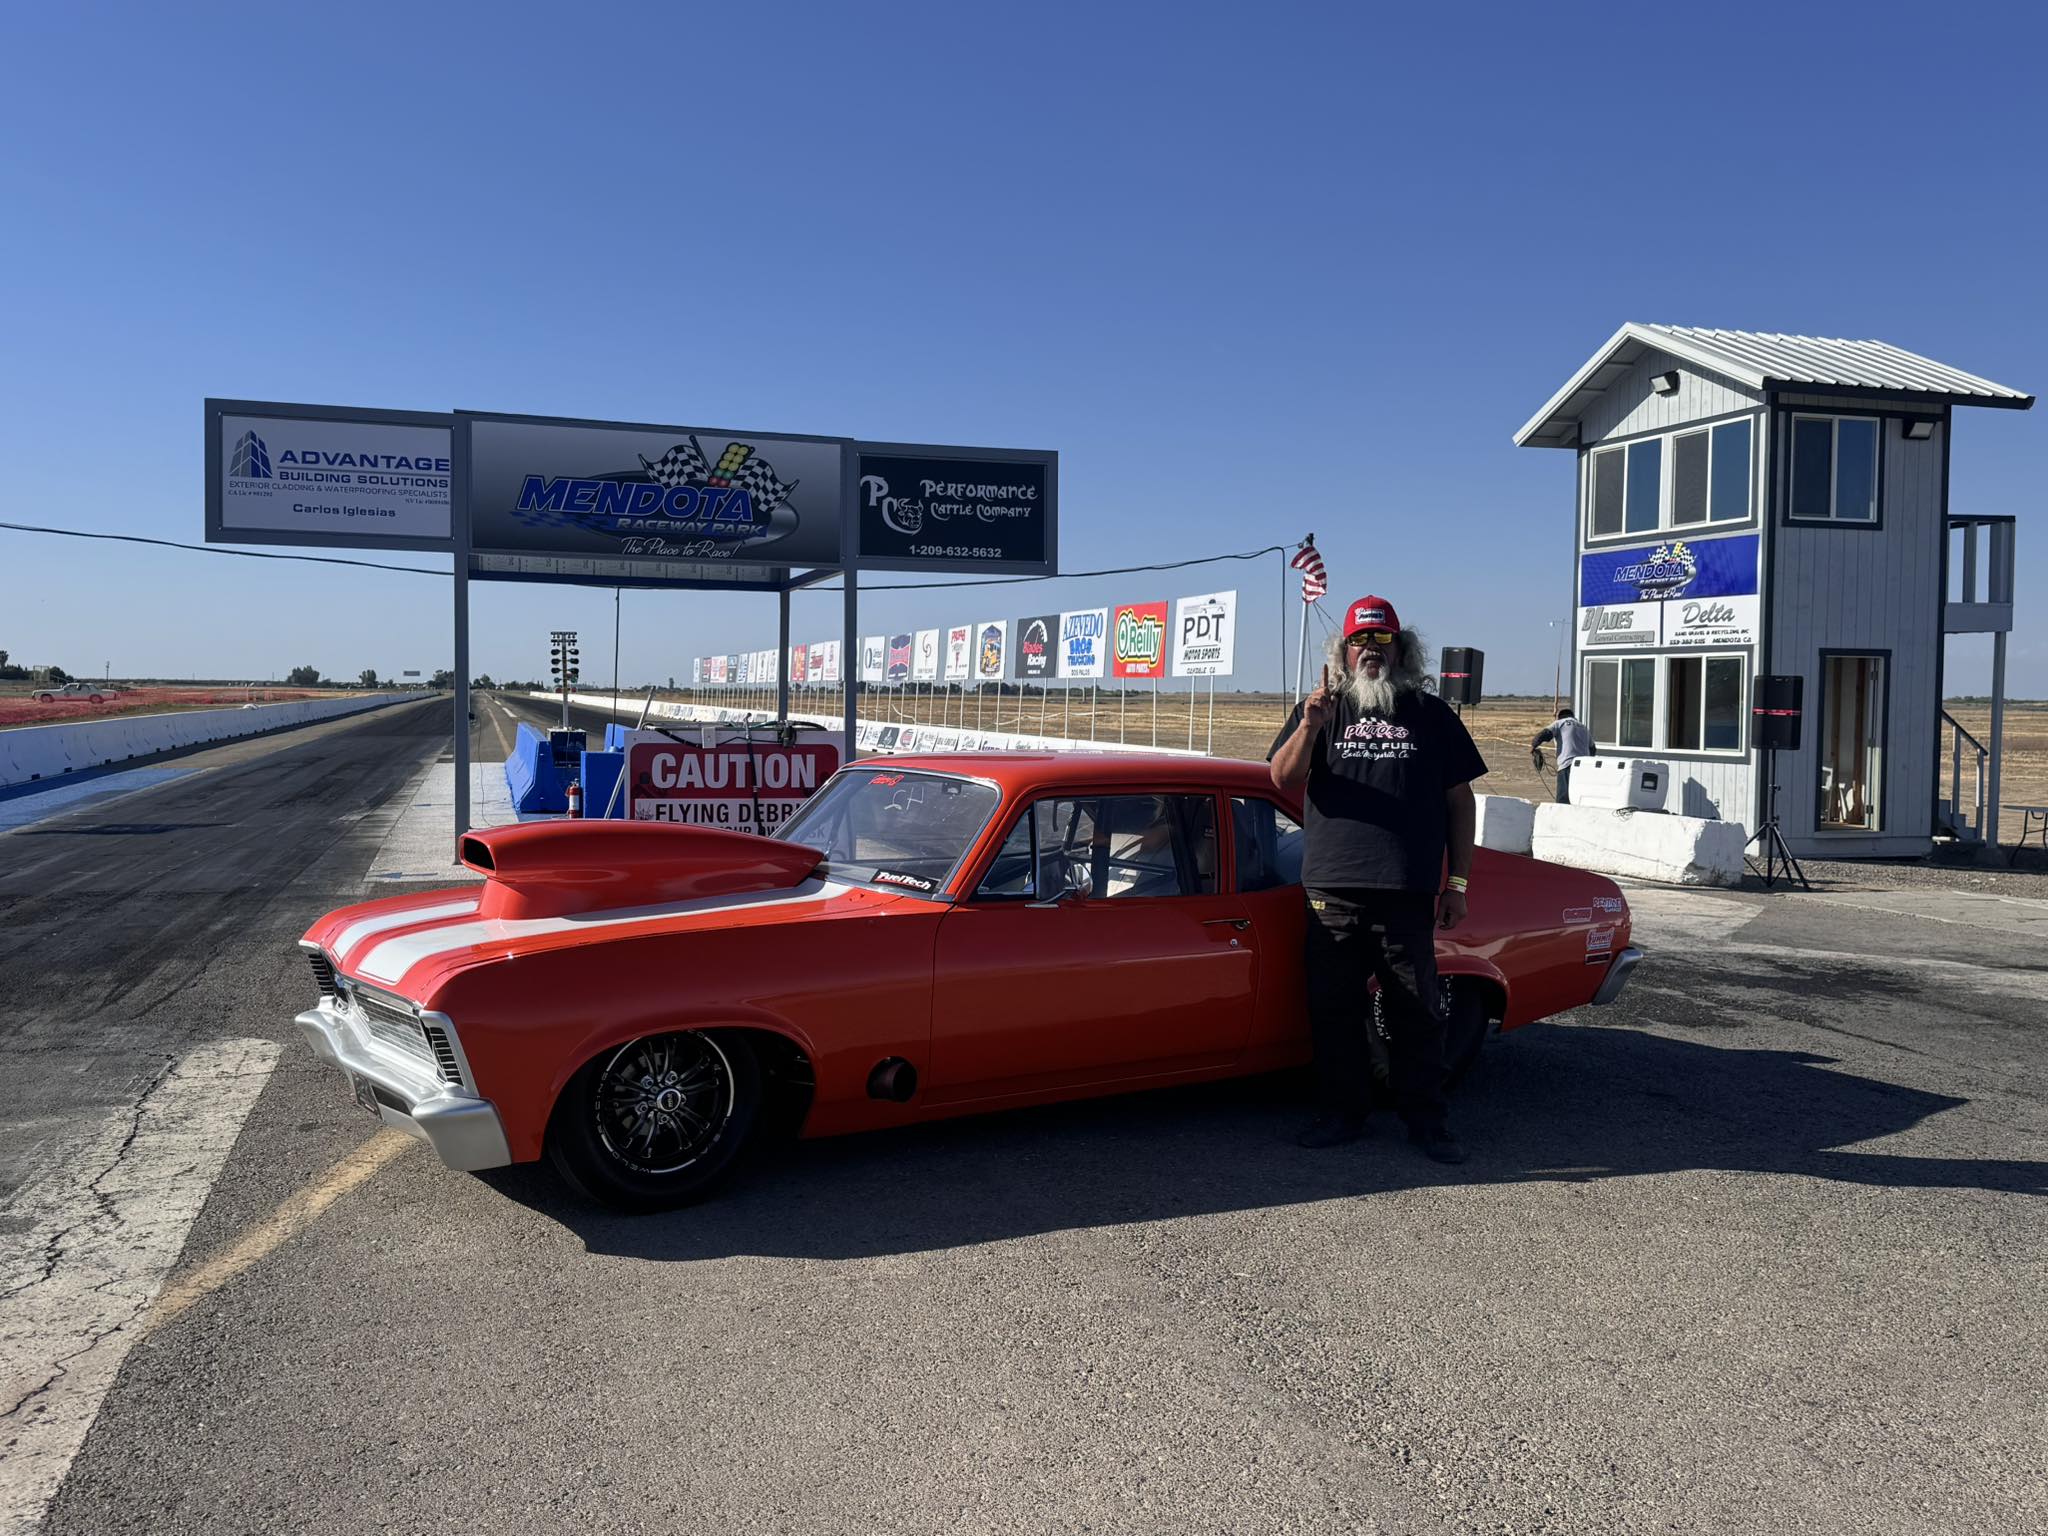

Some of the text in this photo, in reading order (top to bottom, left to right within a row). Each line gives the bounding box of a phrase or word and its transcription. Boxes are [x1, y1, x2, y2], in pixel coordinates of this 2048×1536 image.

[279, 449, 450, 472] ADVANTAGE
[229, 480, 270, 490] EXTERIOR
[271, 482, 315, 492] CLADDING
[323, 485, 398, 496] WATERPROOFING
[398, 488, 448, 499] SPECIALISTS
[279, 471, 449, 489] BUILDING SOLUTIONS
[517, 475, 754, 522] MENDOTA
[292, 503, 396, 518] Carlos Iglesias
[616, 518, 763, 535] RACEWAY PARK
[621, 537, 740, 559] The Place to Race!
[909, 545, 1002, 558] 1-209-632-5632
[1613, 562, 1686, 583] MENDOTA
[1682, 602, 1735, 624] Delta
[1063, 612, 1104, 642] AZEVEDO
[1117, 611, 1162, 661] O'Reilly
[1183, 613, 1225, 647] PDT
[1023, 641, 1044, 654] Blades
[1183, 647, 1221, 661] MOTOR SPORTS
[1027, 654, 1047, 668] Racing
[1067, 655, 1095, 667] TRUCKING
[1334, 742, 1418, 751] TIRE & FUEL
[651, 752, 816, 789] CAUTION
[656, 803, 800, 823] FLYING DEBR
[874, 870, 931, 890] FuelTech
